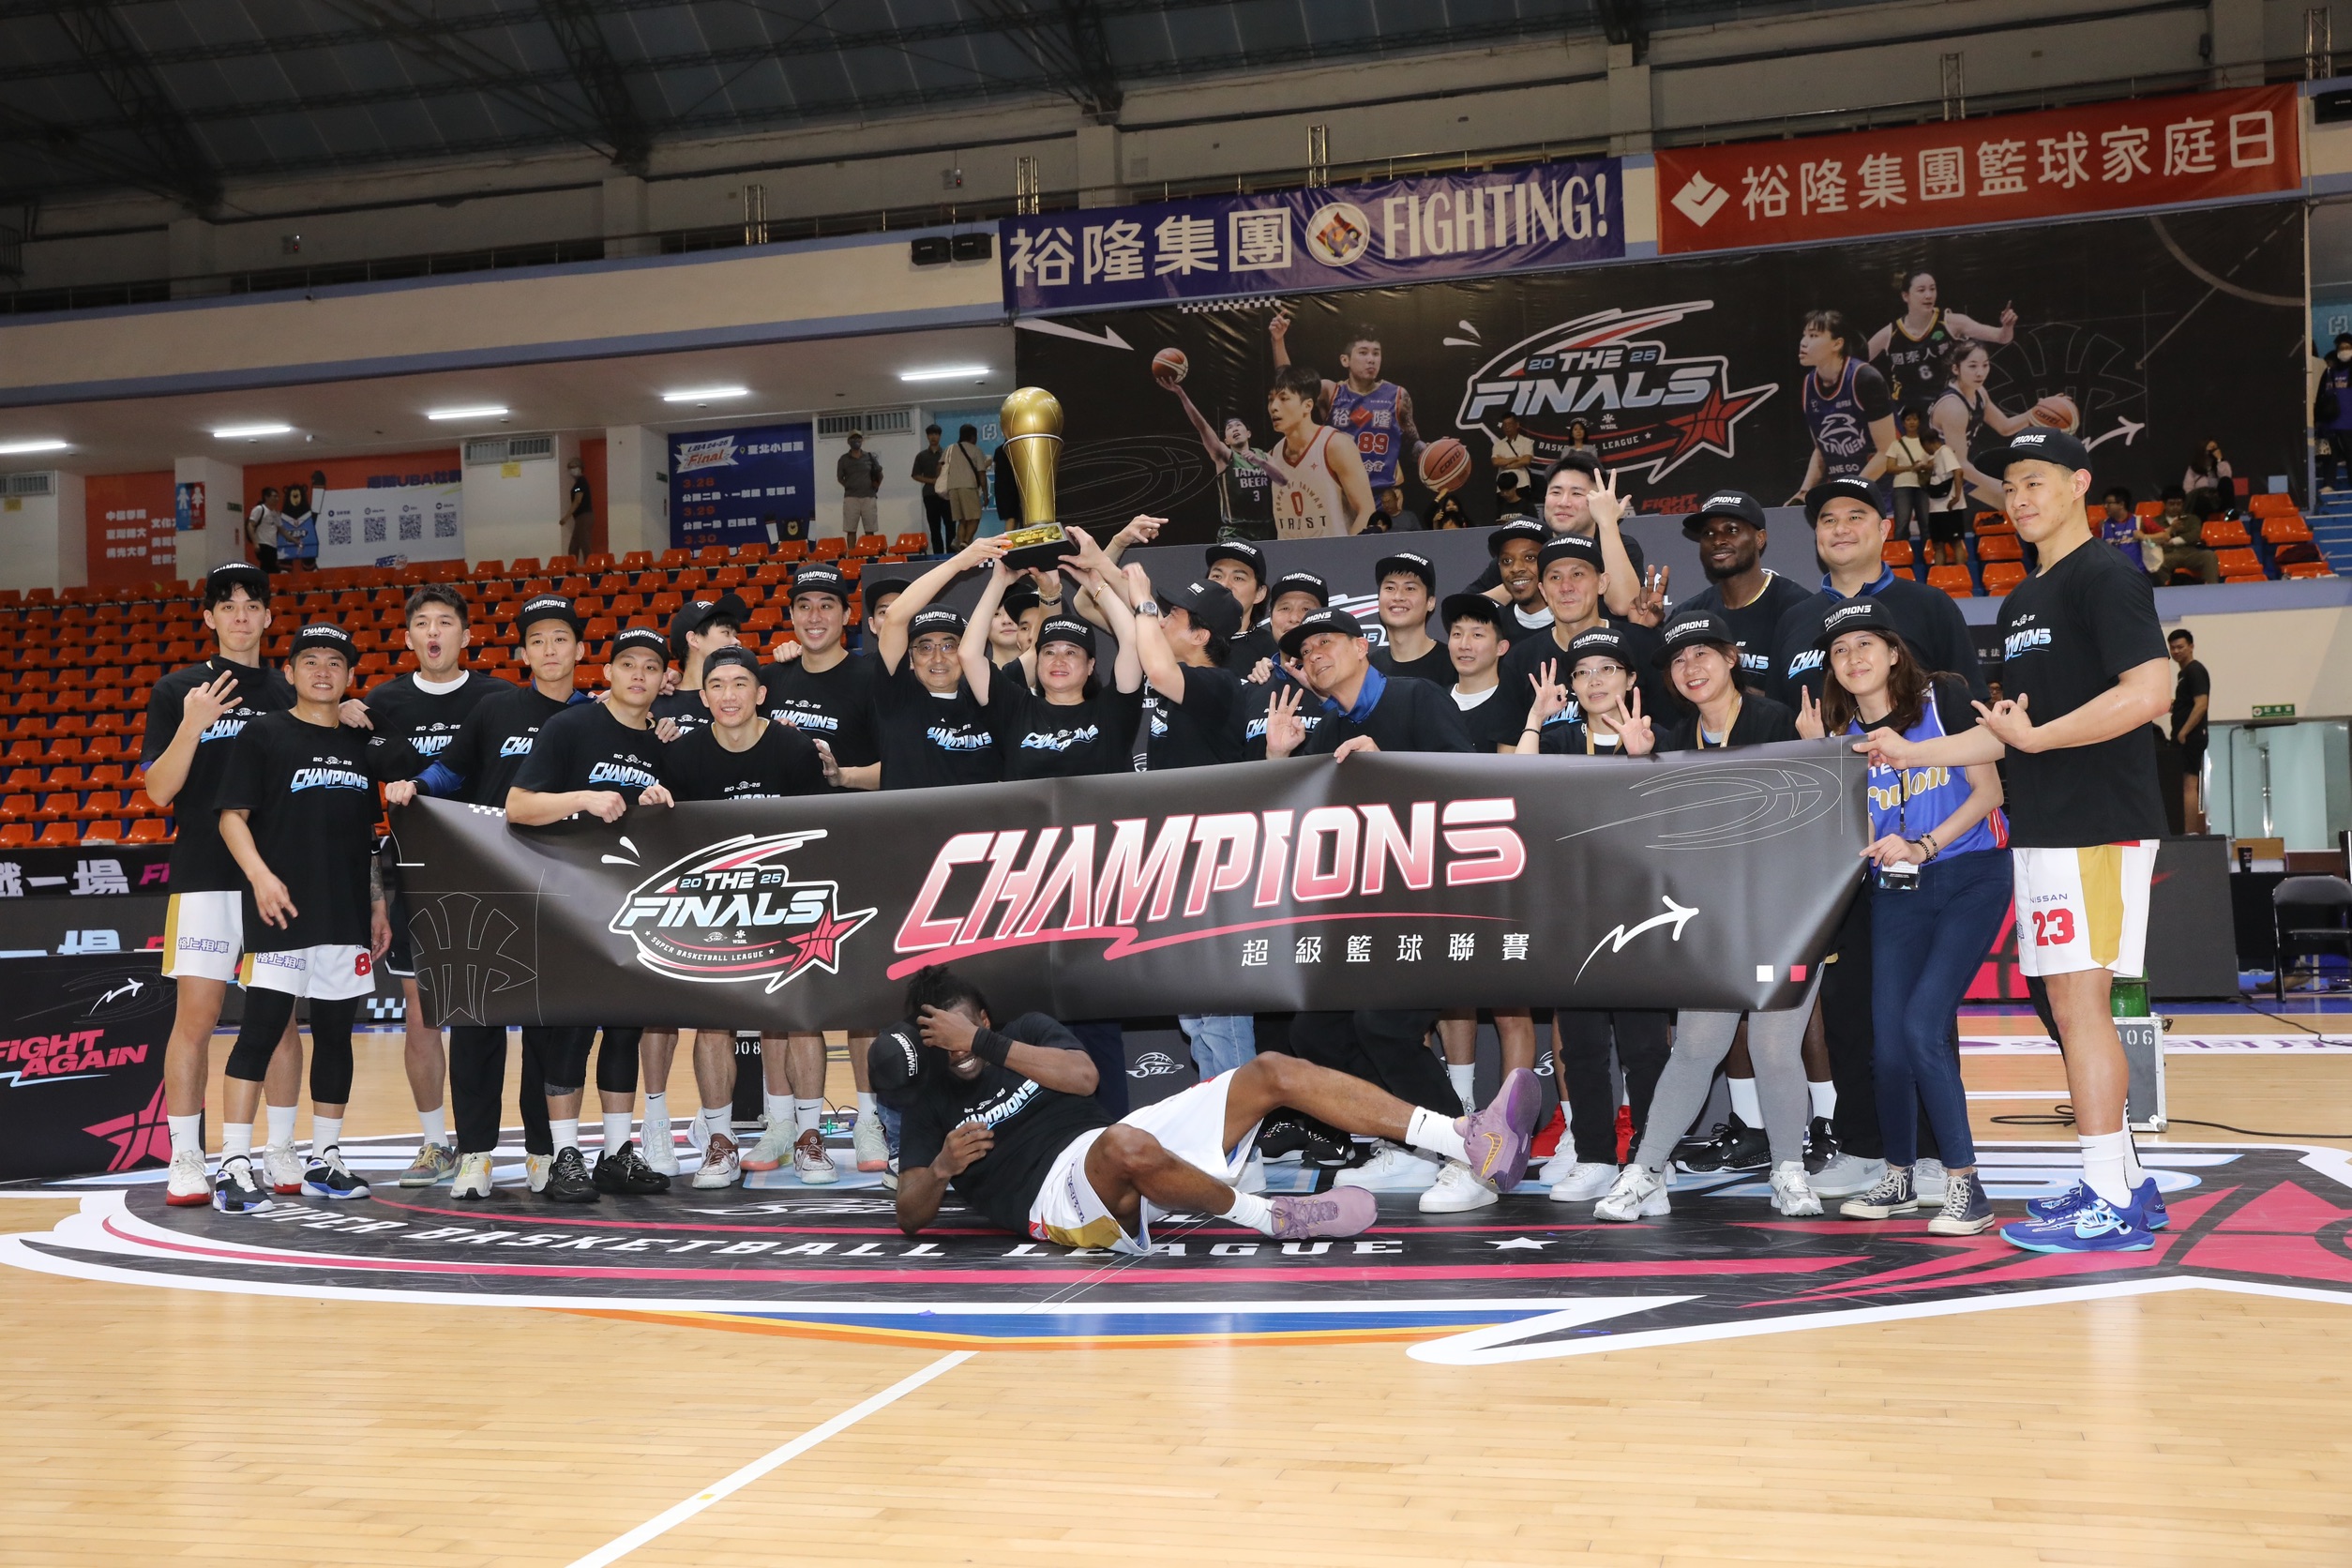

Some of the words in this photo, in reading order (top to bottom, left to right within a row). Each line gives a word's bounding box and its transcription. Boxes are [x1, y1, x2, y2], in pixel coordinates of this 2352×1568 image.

[1742, 110, 2274, 221] 裕隆集團籃球家庭日
[1383, 173, 1607, 259] FIGHTING!
[1009, 207, 1290, 287] 裕隆集團
[1529, 358, 1553, 370] 20
[1560, 350, 1622, 372] THE
[1630, 350, 1657, 363] 25
[1467, 366, 1717, 420] FINALS
[1359, 432, 1389, 454] 89
[1603, 436, 1639, 449] LEAGUE
[2011, 435, 2046, 447] PIONS
[687, 450, 724, 466] Final
[1234, 468, 1267, 478] TAIWA
[1240, 477, 1268, 489] BEER
[1252, 490, 1259, 502] 3
[1642, 493, 1698, 510] FIGHT
[1395, 553, 1429, 565] MPIONS
[797, 570, 837, 581] CHAMPIONS
[1282, 572, 1322, 585] CHAMPIONS
[524, 599, 566, 612] CHAMPIONS
[915, 611, 957, 623] CHAMPIONS
[1302, 611, 1332, 625] MPIONS
[1824, 605, 1872, 627] CHAMPIONS
[302, 626, 347, 641] CHAMPIONS
[620, 630, 664, 643] CHAMPIONS
[1045, 621, 1088, 634] CHAMPIONS
[1665, 620, 1710, 641] CHAMPIONS
[1574, 634, 1619, 649] CHAMPIONS
[291, 768, 369, 790] CHAMPIONS
[589, 761, 659, 787] CHAMPION
[680, 878, 701, 889] 20
[705, 872, 756, 890] THE
[760, 873, 782, 884] 25
[894, 797, 1527, 953] CHAMPIONS
[2030, 893, 2068, 903] NISSAN
[620, 889, 830, 927] FINALS
[2032, 908, 2074, 946] 23
[178, 937, 229, 954] 格上租車
[651, 936, 674, 954] SUPER
[676, 949, 728, 962] BASKETBALL
[731, 950, 764, 962] LEAGUE
[1242, 932, 1530, 968] 超級籃球聯賽
[256, 951, 307, 972] 格上租車
[354, 952, 372, 976] 8
[22, 1044, 148, 1078] AGAIN
[400, 1227, 946, 1258] BASKETBALL
